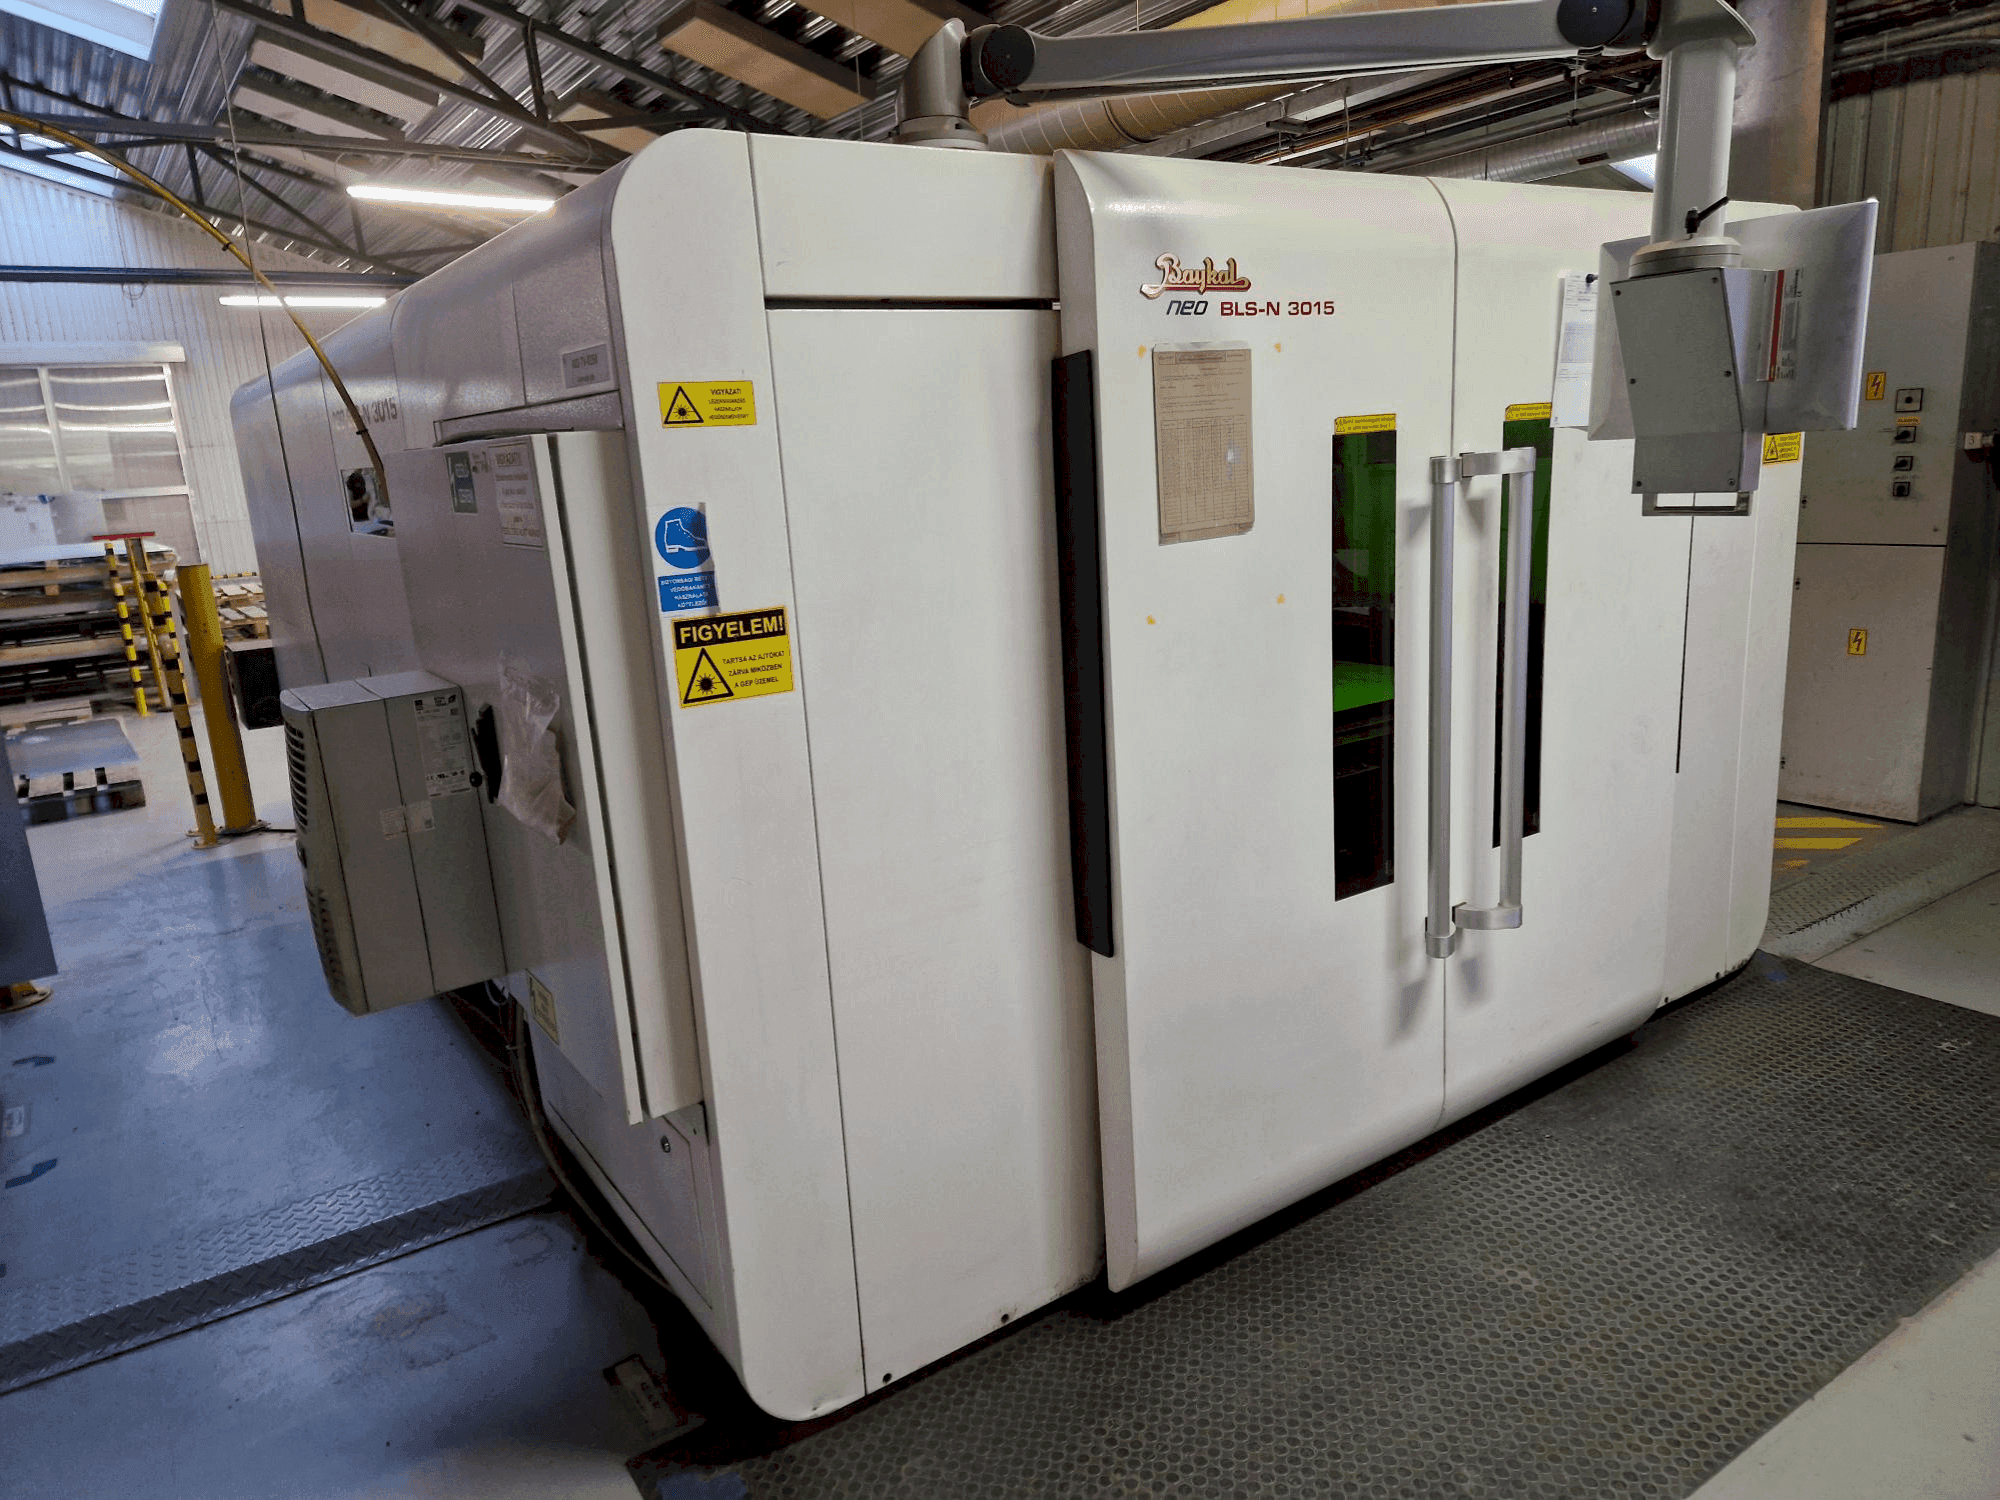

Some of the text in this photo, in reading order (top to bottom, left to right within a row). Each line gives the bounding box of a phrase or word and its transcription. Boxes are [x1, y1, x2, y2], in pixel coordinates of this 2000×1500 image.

[1140, 252, 1251, 300] Baykal
[1220, 301, 1280, 316] BLS-N
[1288, 301, 1335, 316] 3015
[680, 615, 784, 644] FIGYELEM!
